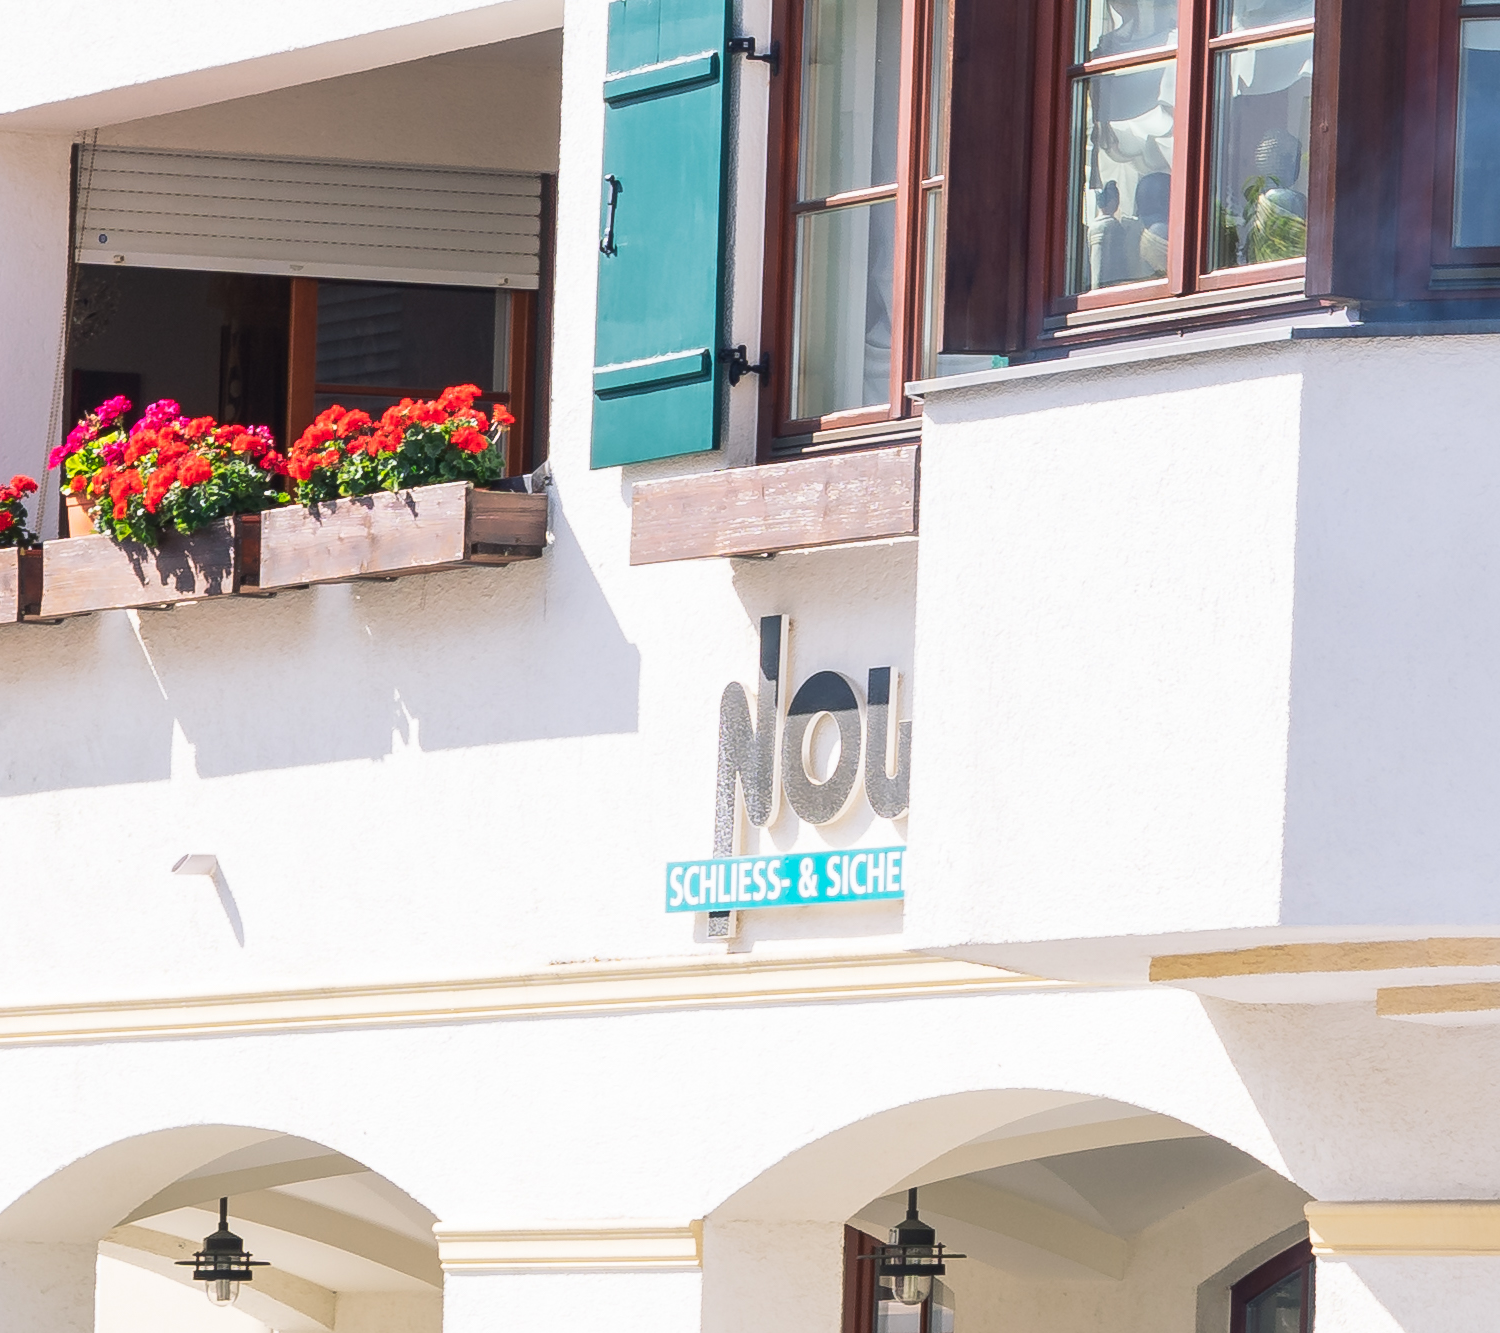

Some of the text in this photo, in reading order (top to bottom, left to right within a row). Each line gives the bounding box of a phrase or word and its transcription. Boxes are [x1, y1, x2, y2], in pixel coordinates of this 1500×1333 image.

[670, 850, 905, 907] SCHLIESS- & SICHE
